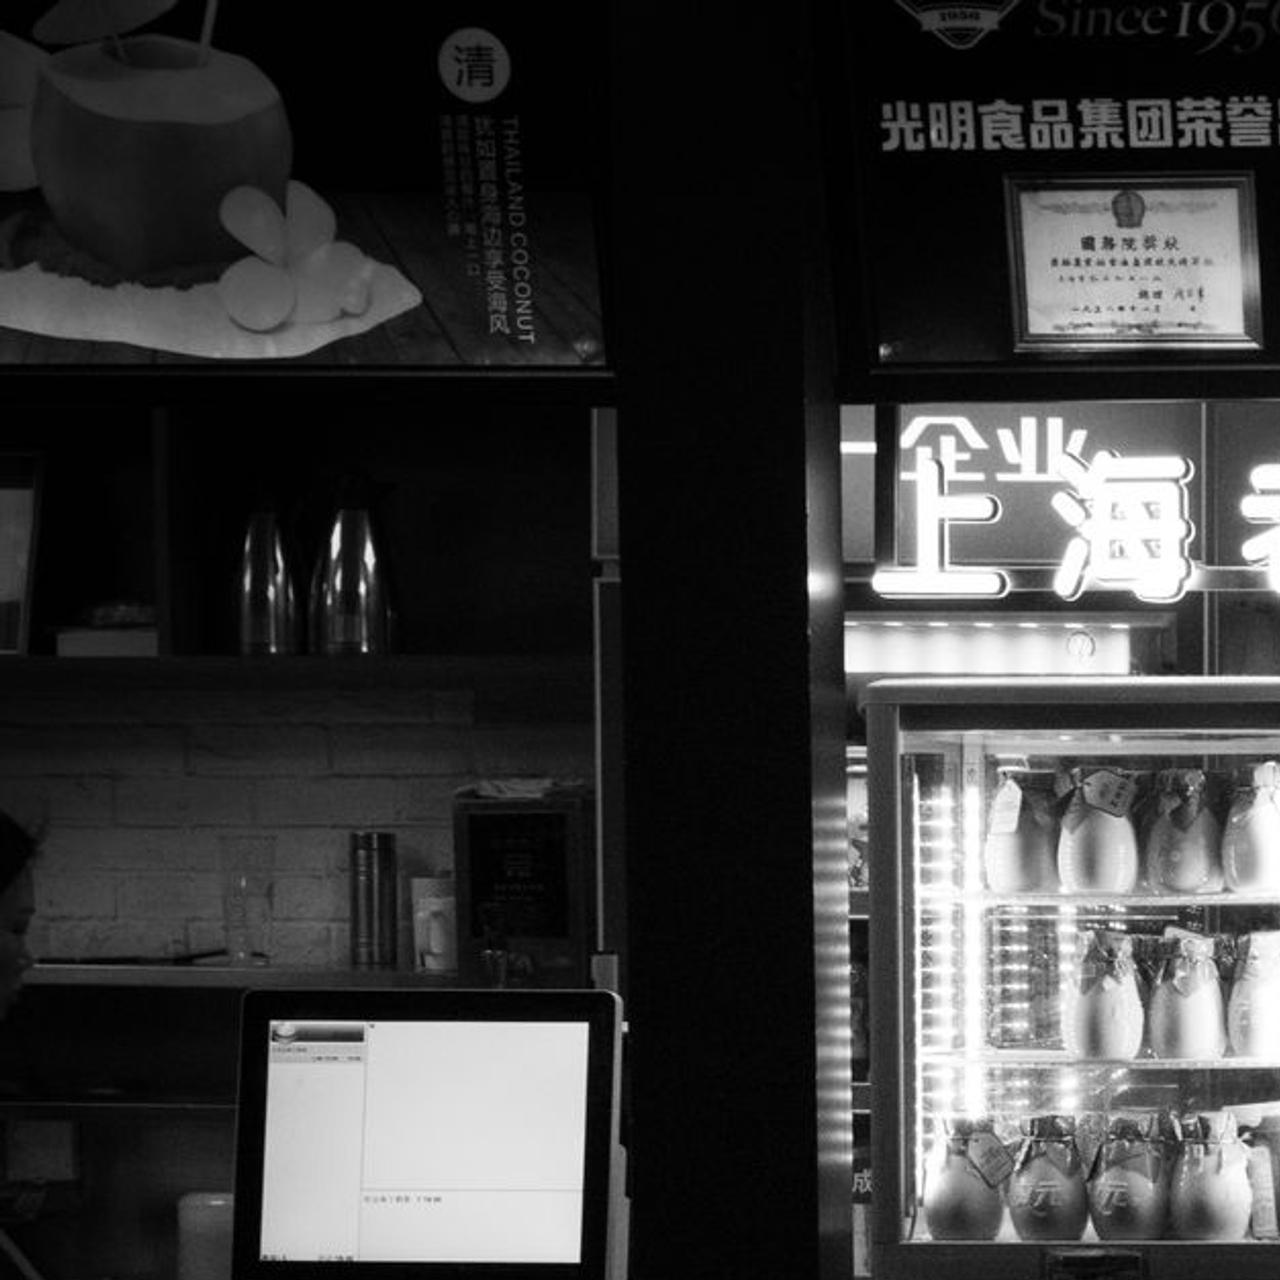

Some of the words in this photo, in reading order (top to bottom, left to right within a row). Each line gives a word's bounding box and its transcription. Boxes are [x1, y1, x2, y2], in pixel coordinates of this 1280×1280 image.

[454, 44, 497, 88] 清
[501, 115, 527, 229] THAILAND
[510, 231, 536, 345] COCONUT
